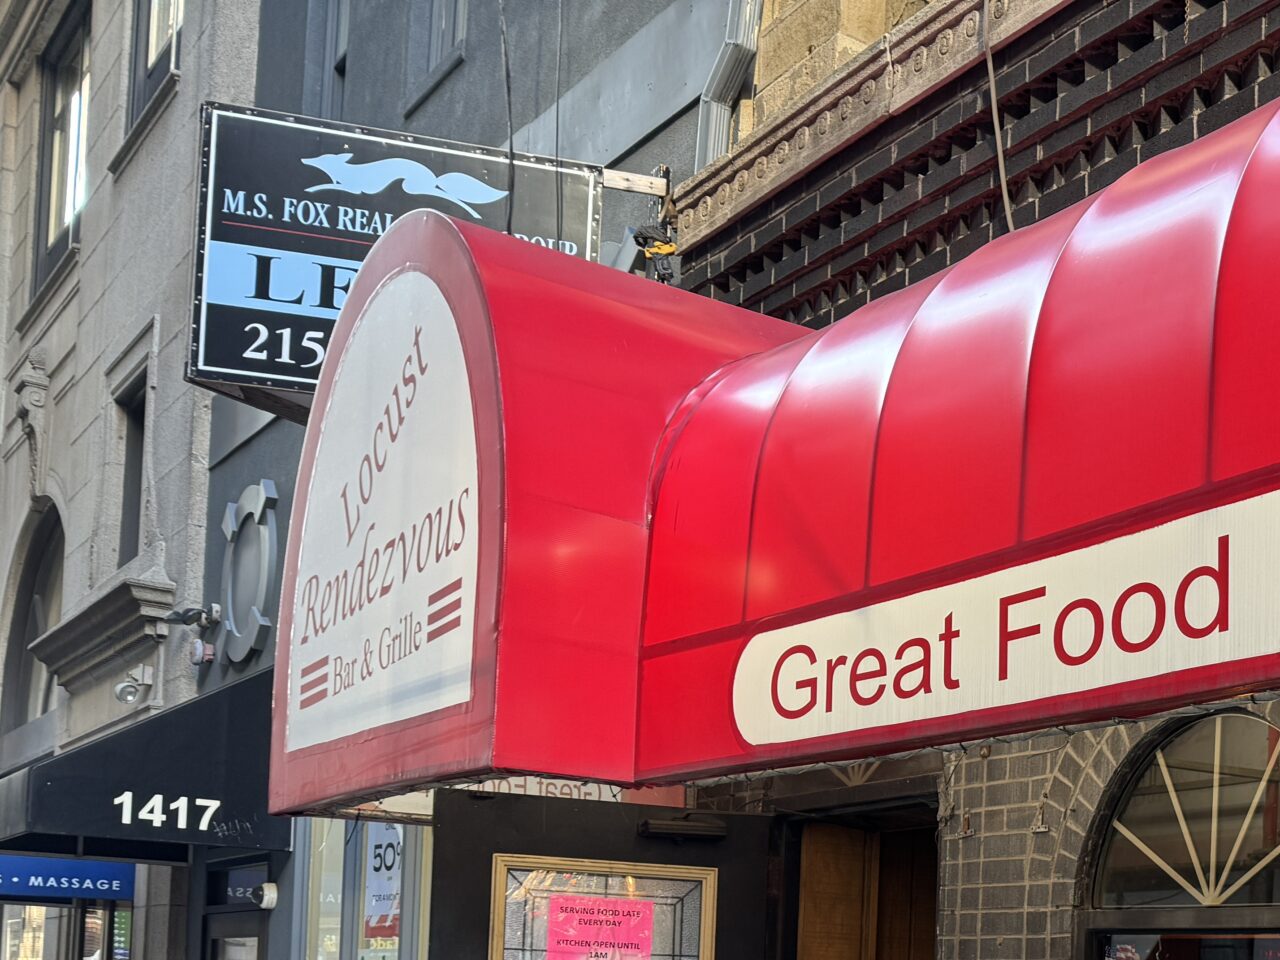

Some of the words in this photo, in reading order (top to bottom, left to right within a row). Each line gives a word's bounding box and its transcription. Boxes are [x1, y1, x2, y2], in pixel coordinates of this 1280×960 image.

[221, 188, 274, 219] M.S.
[281, 197, 331, 229] FOX
[241, 322, 326, 369] 215
[338, 324, 430, 549] Locust
[300, 486, 470, 647] Rendezvous
[769, 611, 962, 720] Great
[997, 533, 1231, 683] Food
[332, 654, 358, 697] Bar
[360, 637, 374, 680] &
[378, 611, 424, 672] Grille
[112, 790, 222, 832] 1417
[28, 875, 121, 891] MASSAGE
[559, 905, 595, 916] SERVING
[597, 908, 620, 917] FOOD
[621, 909, 641, 918] LATE
[578, 918, 605, 927] EVERY
[605, 919, 623, 928] DAY
[556, 939, 591, 948] KITCHEN
[592, 940, 616, 949] OPEN
[616, 941, 641, 950] UNTIL
[589, 951, 608, 960] 1AM
